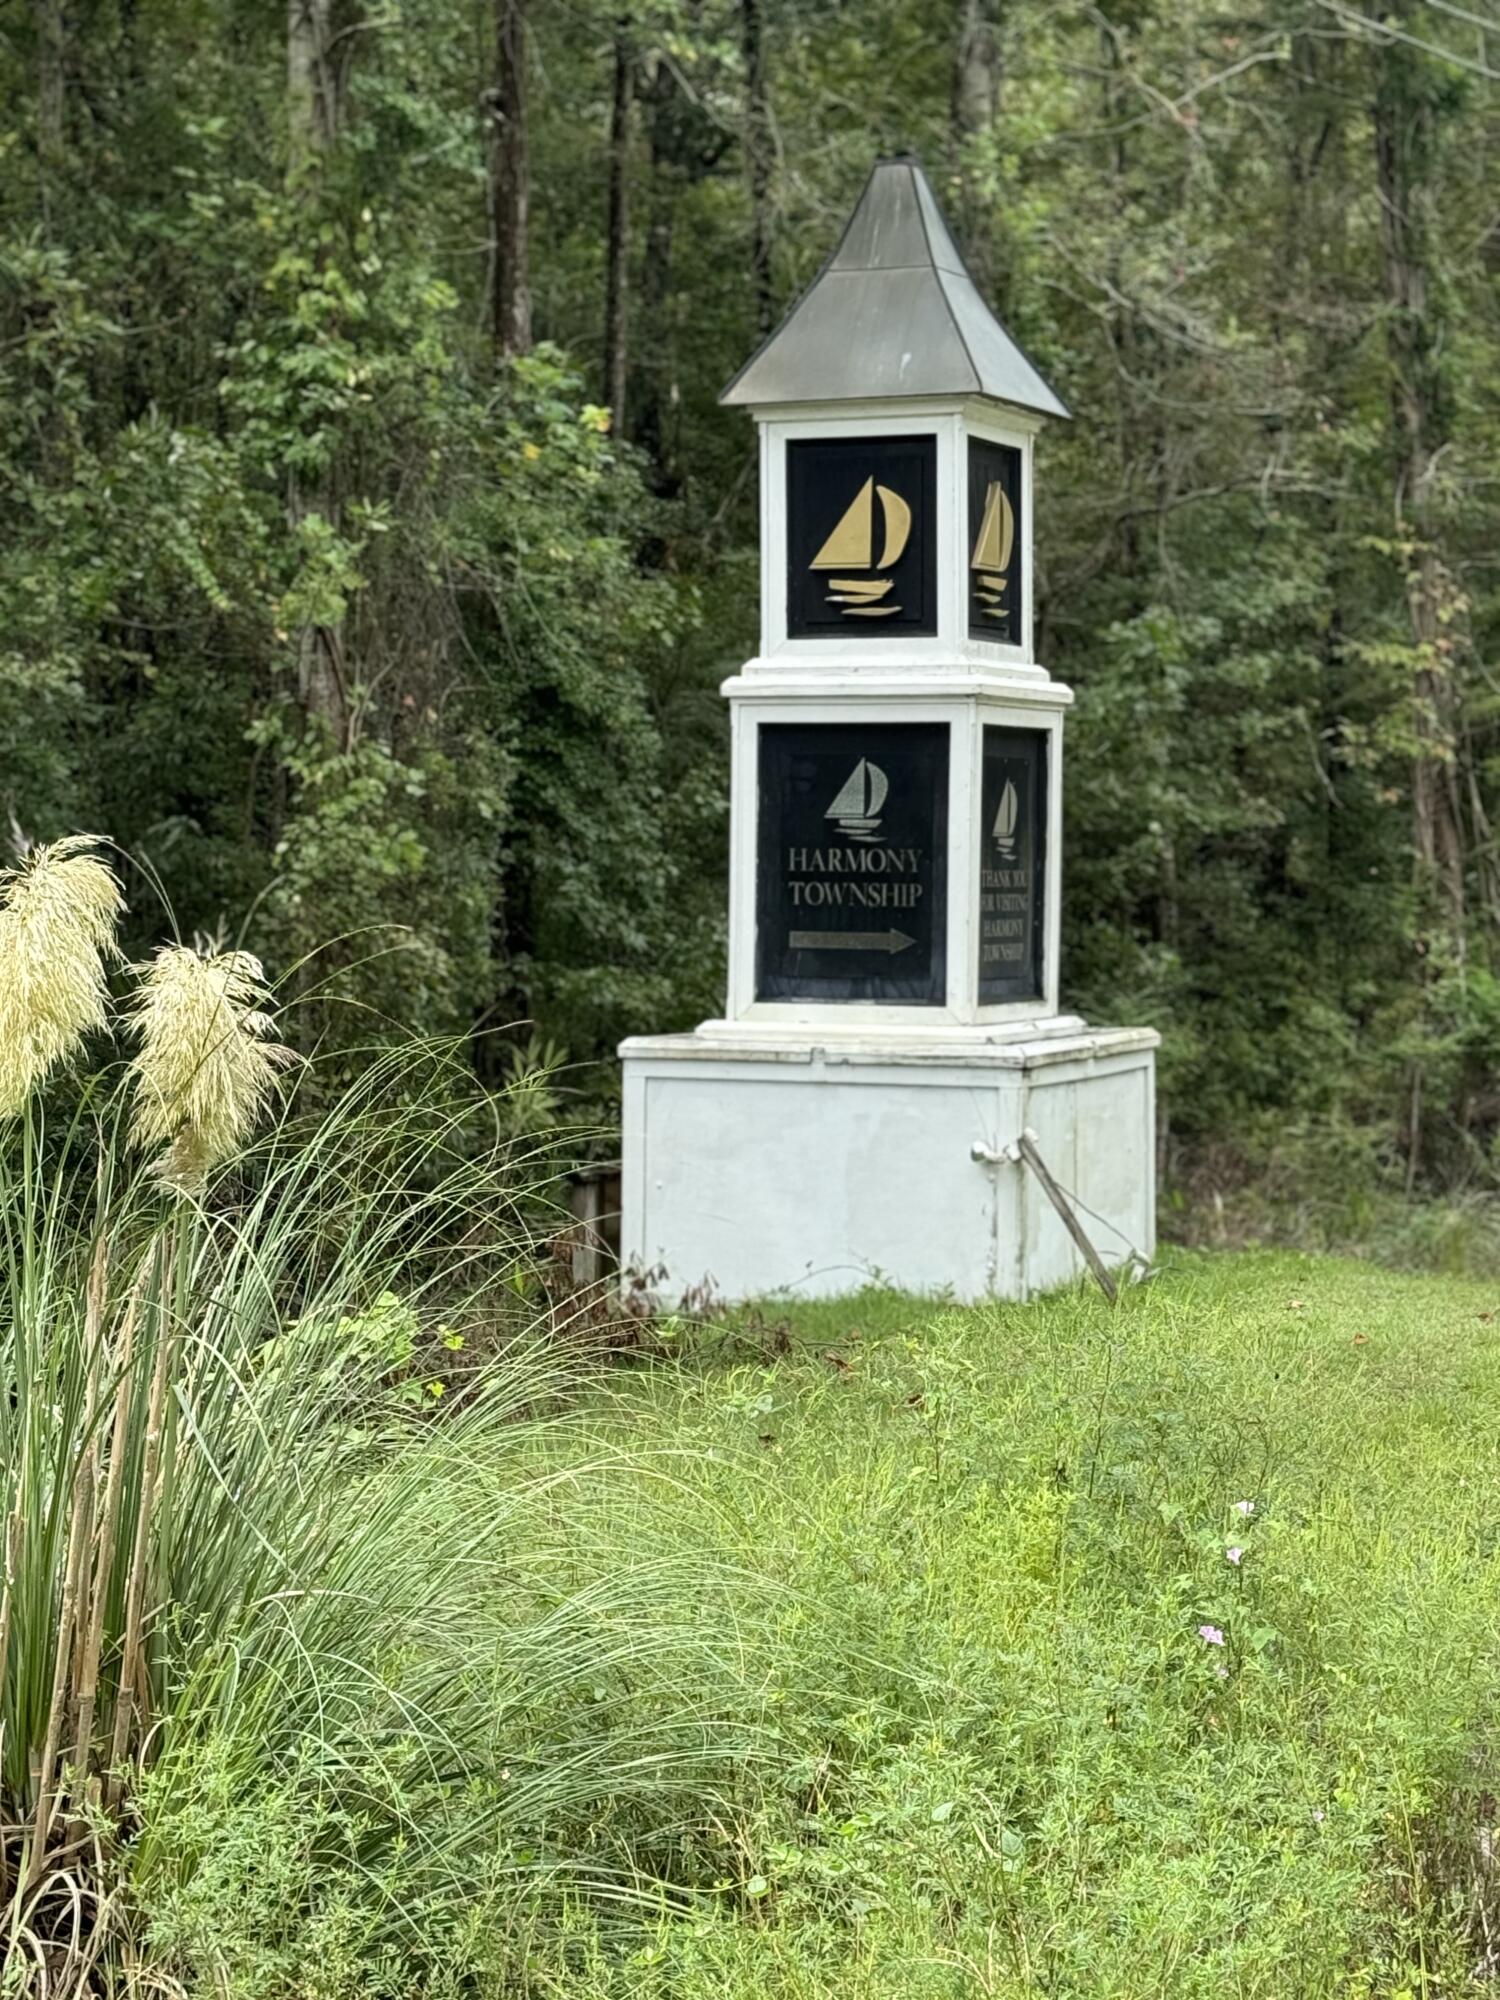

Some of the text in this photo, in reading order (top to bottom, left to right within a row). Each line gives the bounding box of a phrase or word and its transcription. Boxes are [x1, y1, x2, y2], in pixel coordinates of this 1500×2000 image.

[788, 847, 923, 873] HARMONY
[788, 881, 923, 907] TOWNSHIP
[983, 918, 1024, 937] HARMONY
